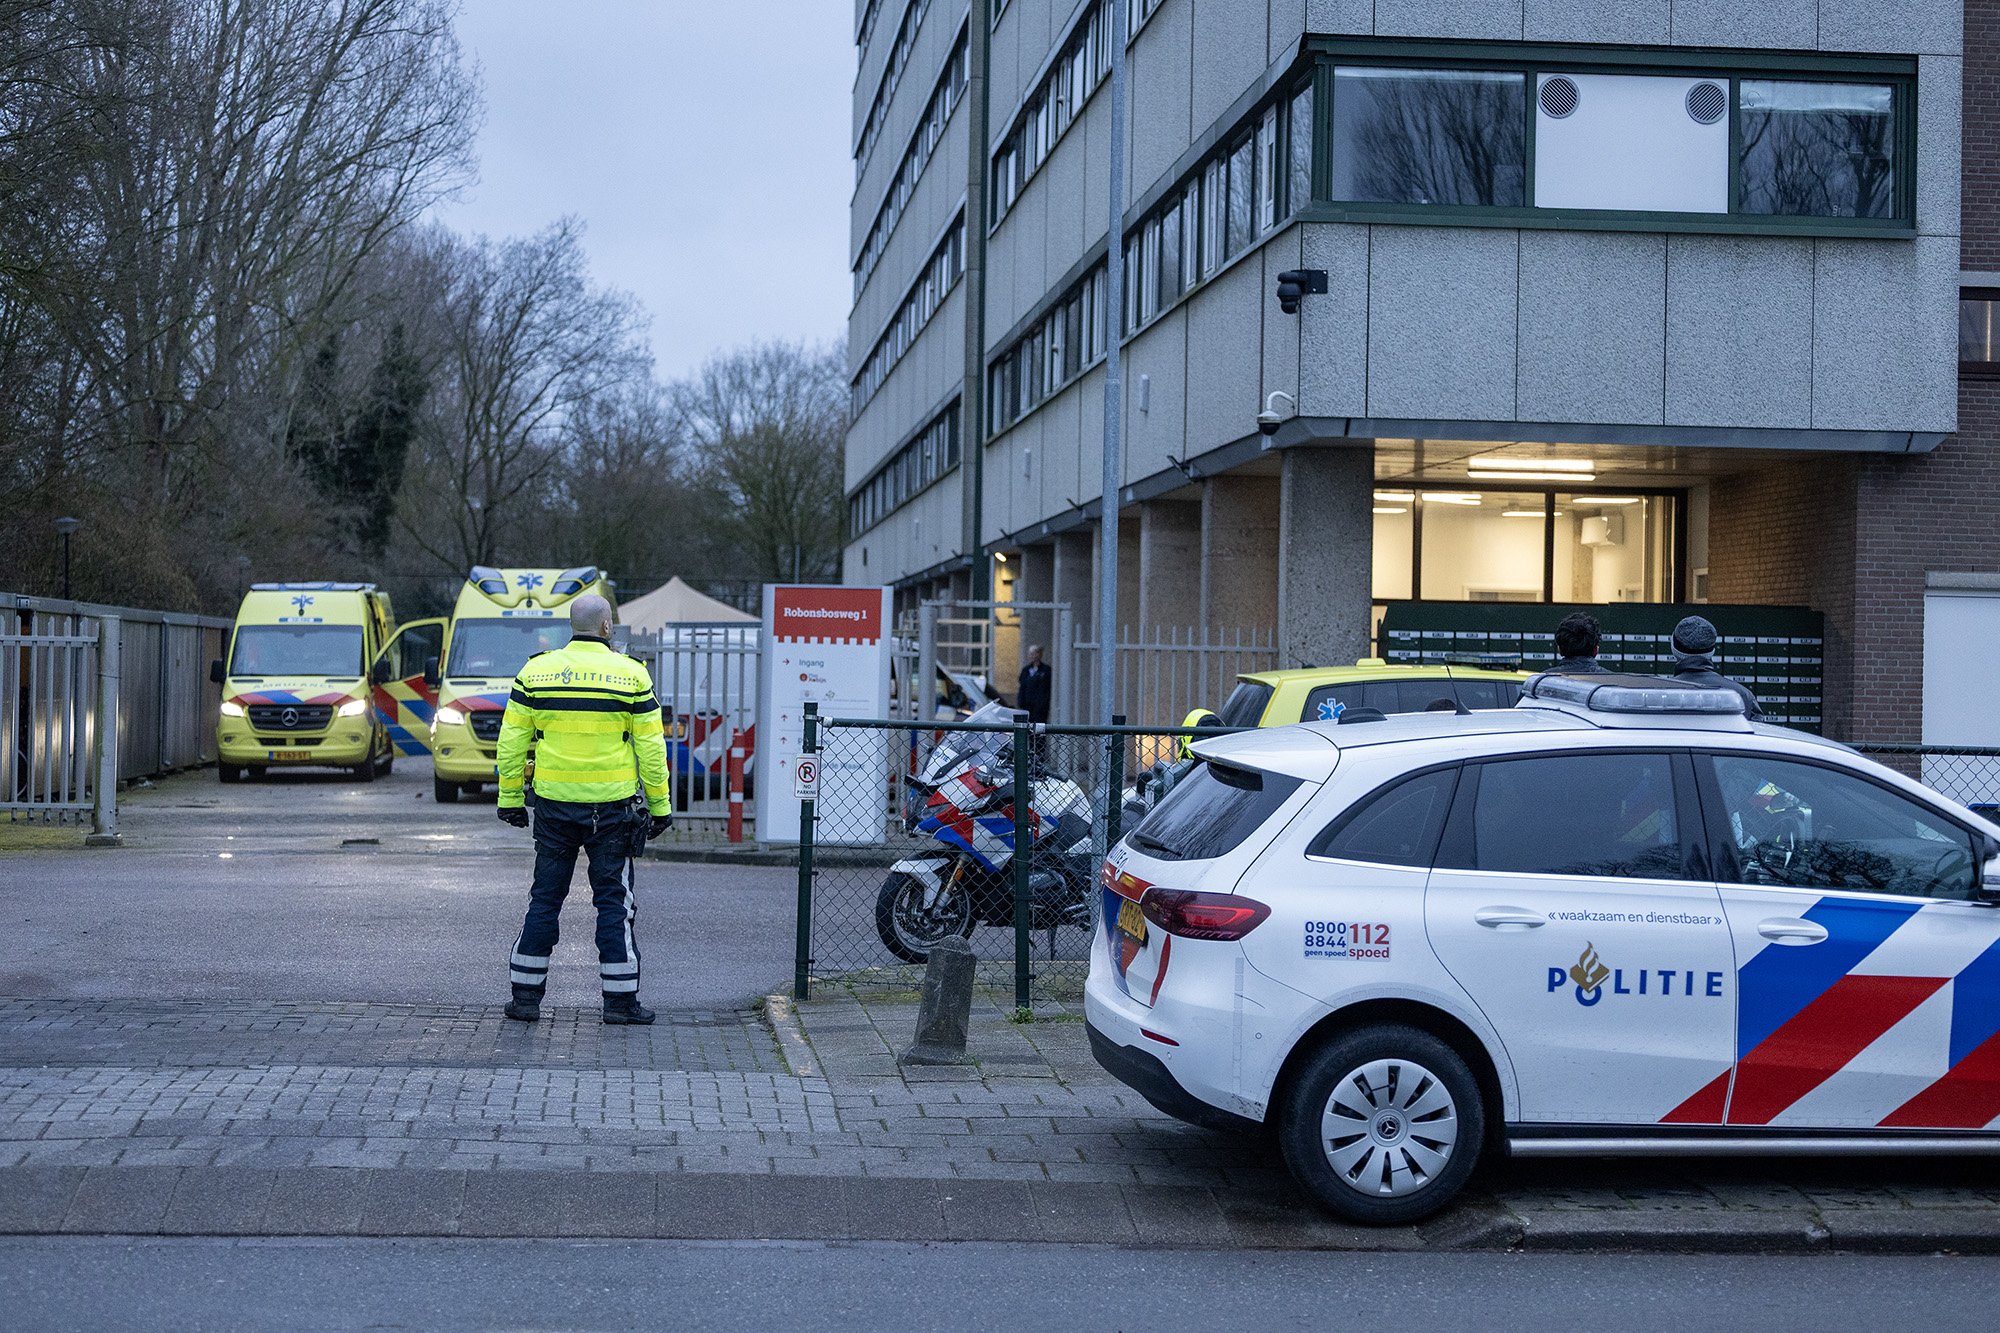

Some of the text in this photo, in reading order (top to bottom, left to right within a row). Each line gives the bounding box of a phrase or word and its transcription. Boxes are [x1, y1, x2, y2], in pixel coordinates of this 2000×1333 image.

[783, 607, 867, 621] Robonsbosweg 1
[799, 659, 824, 668] Ingang
[554, 671, 612, 684] POLITIE
[1558, 910, 1626, 921] waakzaam
[1628, 913, 1643, 922] en
[1646, 912, 1711, 924] dienstbaar
[1305, 921, 1346, 934] 0900
[1349, 923, 1389, 944] 112
[1305, 935, 1346, 948] 8844
[1349, 947, 1389, 960] spoed
[1548, 965, 1723, 1007] POLITIE
